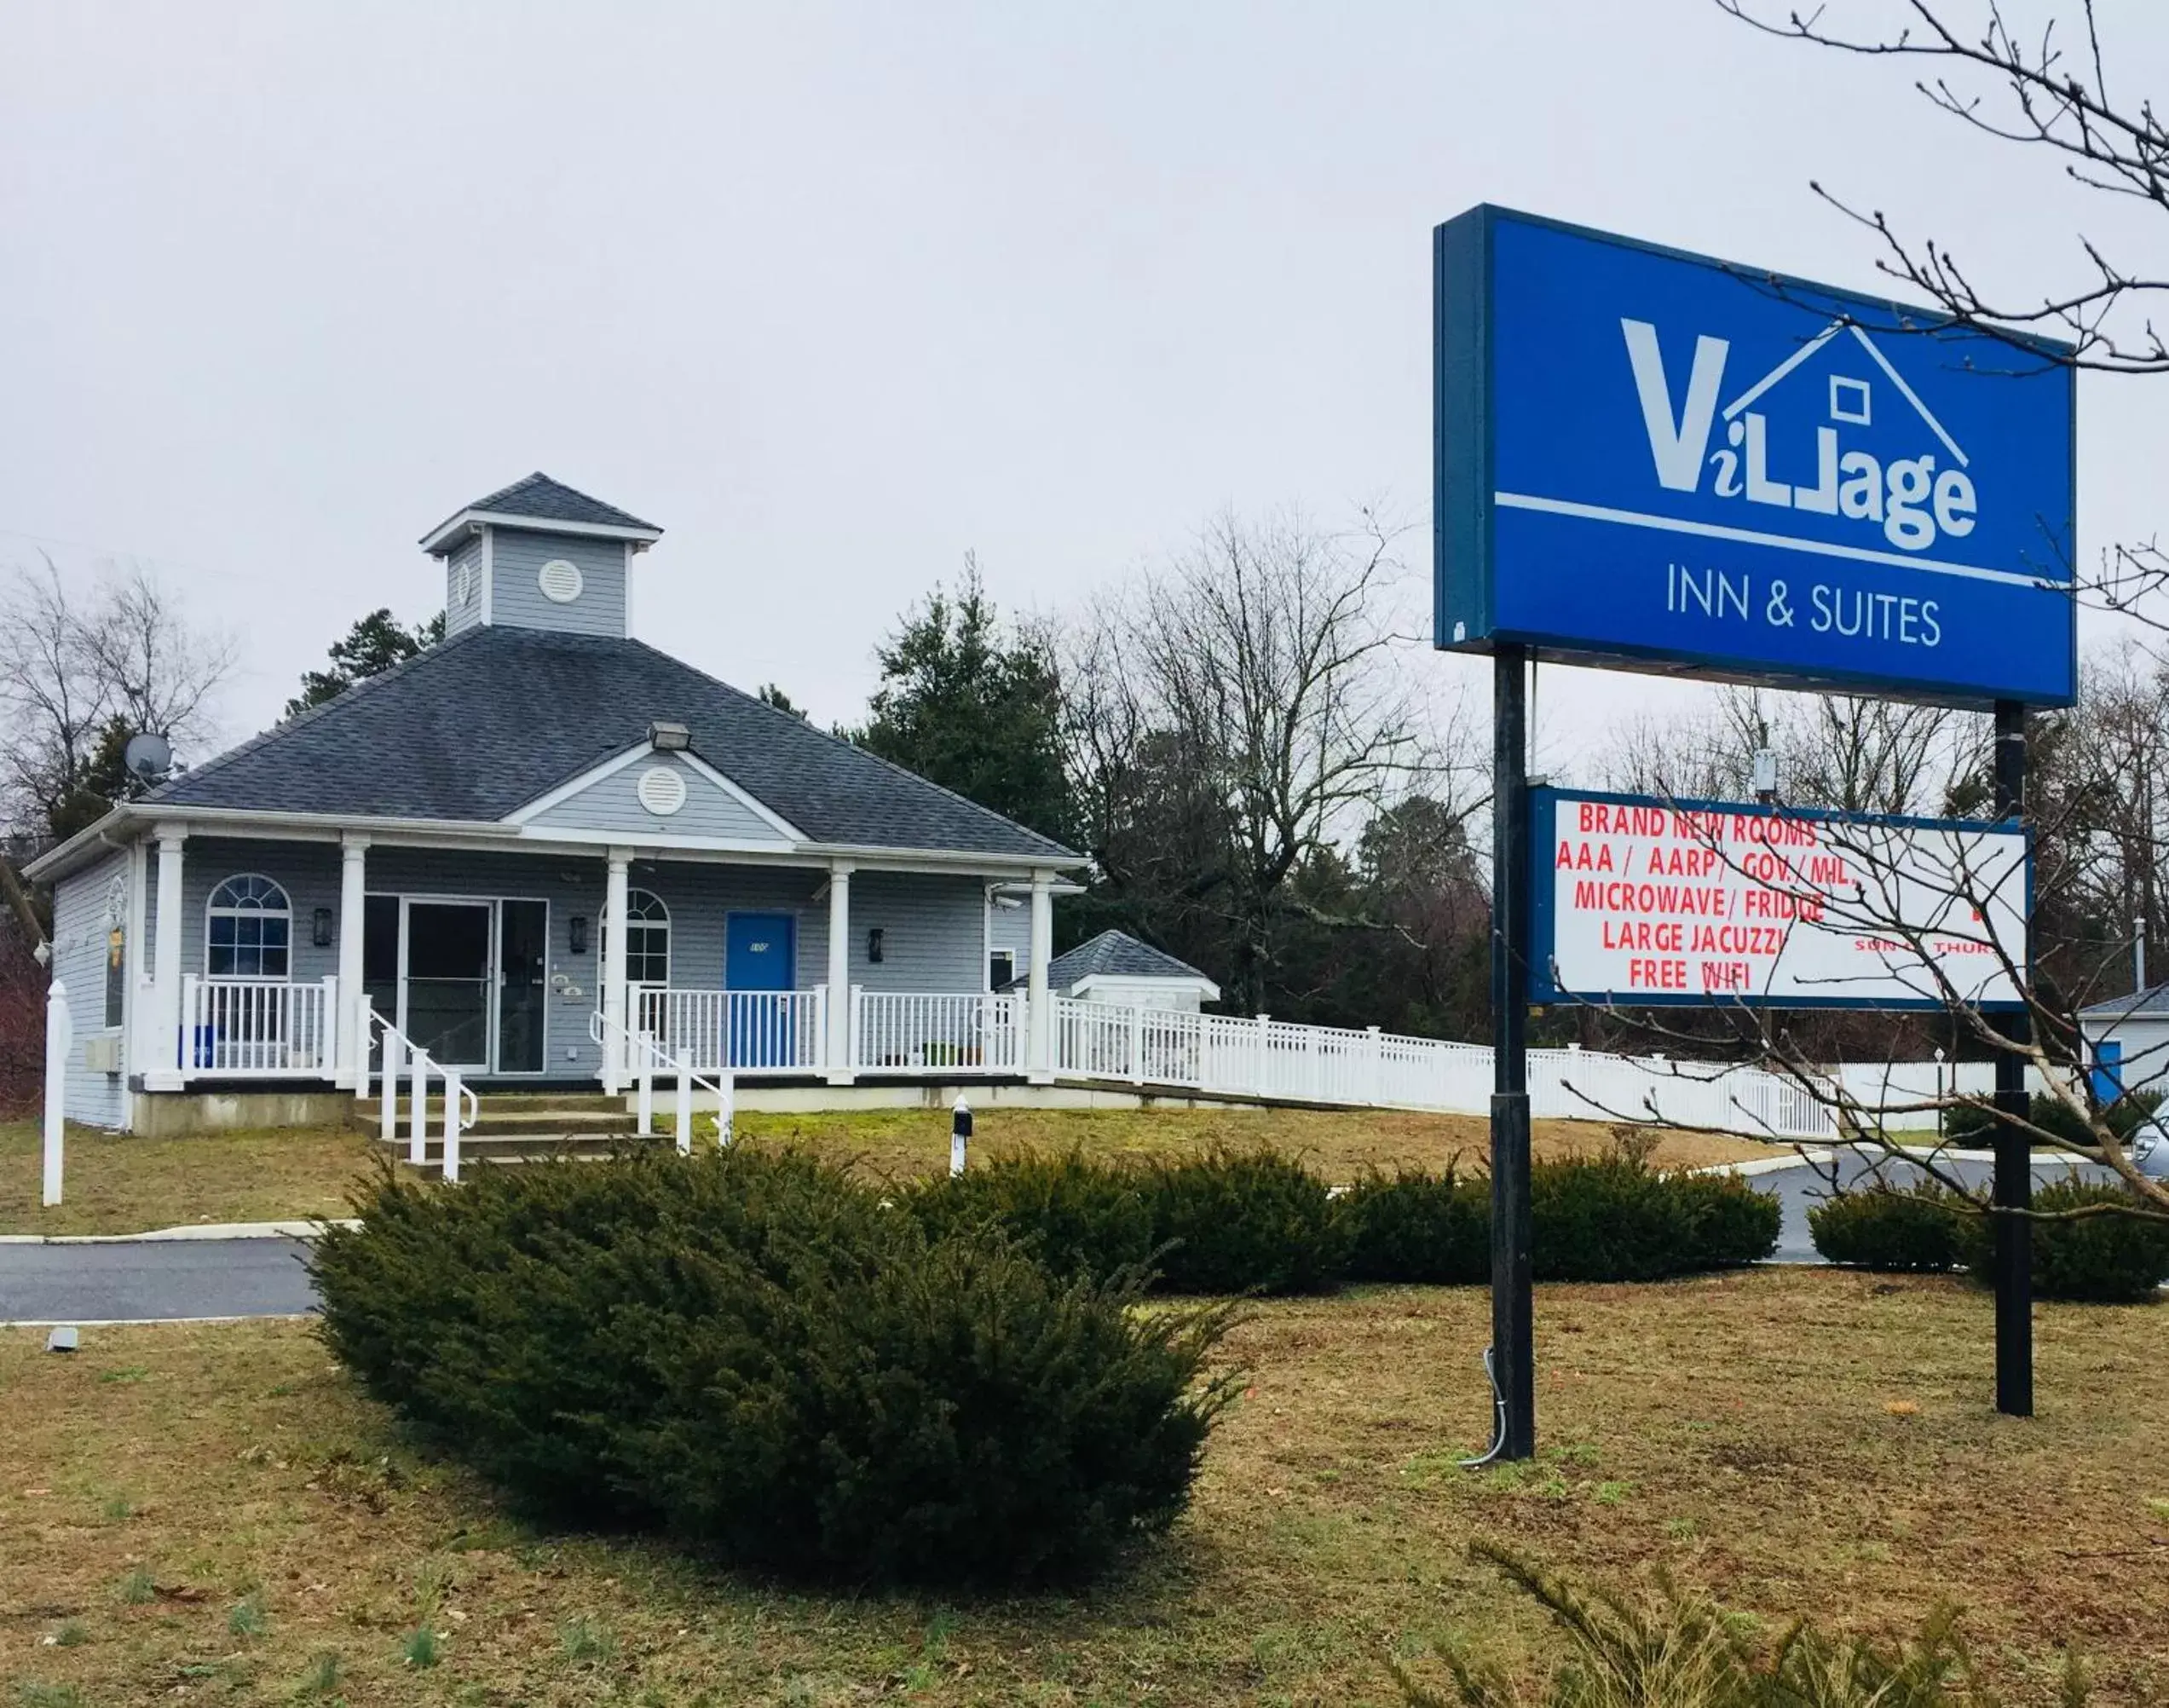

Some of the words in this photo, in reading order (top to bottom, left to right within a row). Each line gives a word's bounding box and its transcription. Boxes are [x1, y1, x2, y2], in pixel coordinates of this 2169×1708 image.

[1668, 563, 1750, 620] INN
[1766, 580, 1795, 628] &
[1811, 585, 1941, 648] SUITES
[1579, 804, 1665, 837] BRAND
[1673, 811, 1725, 841] NEW
[1733, 814, 1817, 847] ROOMS
[1556, 840, 1613, 873] AAA
[1745, 890, 1825, 920] FRIDGE
[1603, 920, 1683, 952] LARGE
[1691, 925, 1784, 955] JACUZZI
[1630, 959, 1687, 989] FREE
[1701, 961, 1750, 990] WIFI
